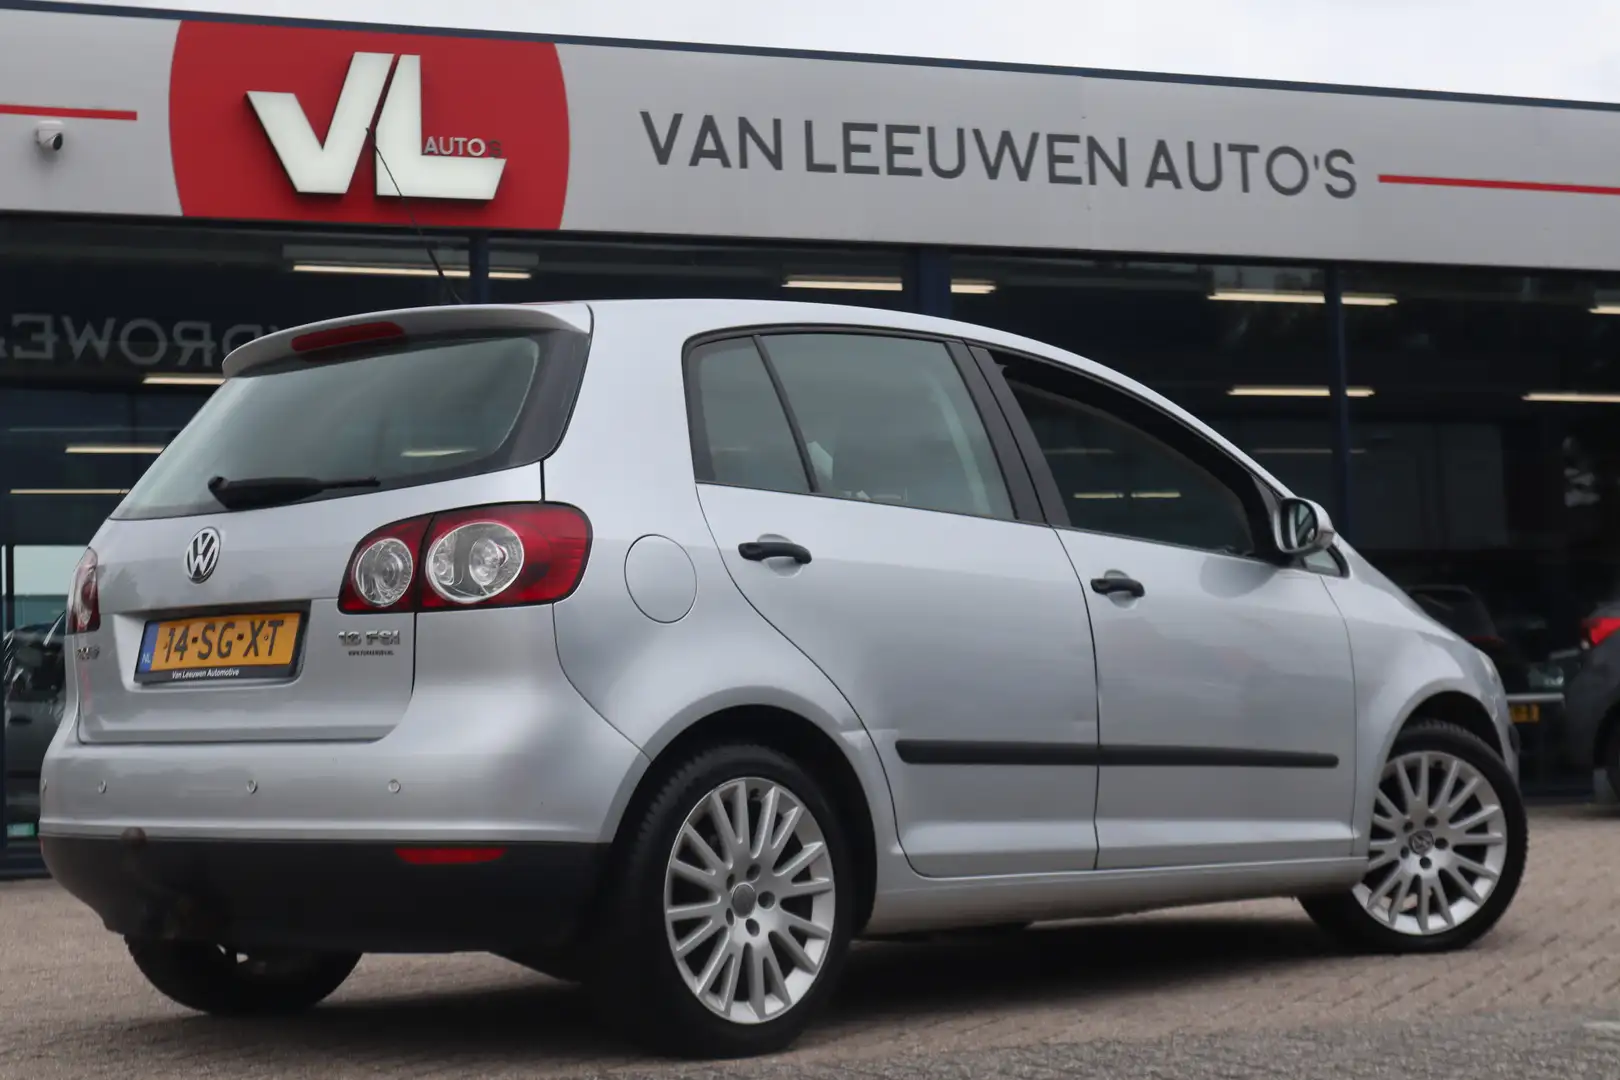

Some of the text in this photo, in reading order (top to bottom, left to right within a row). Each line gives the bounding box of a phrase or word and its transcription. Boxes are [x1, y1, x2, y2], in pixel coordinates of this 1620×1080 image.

[640, 110, 1357, 200] VAN LEEUWEN AUTO'S
[163, 619, 285, 663] 14-SG-XT
[172, 667, 240, 679] Van Leeuwen Automotive
